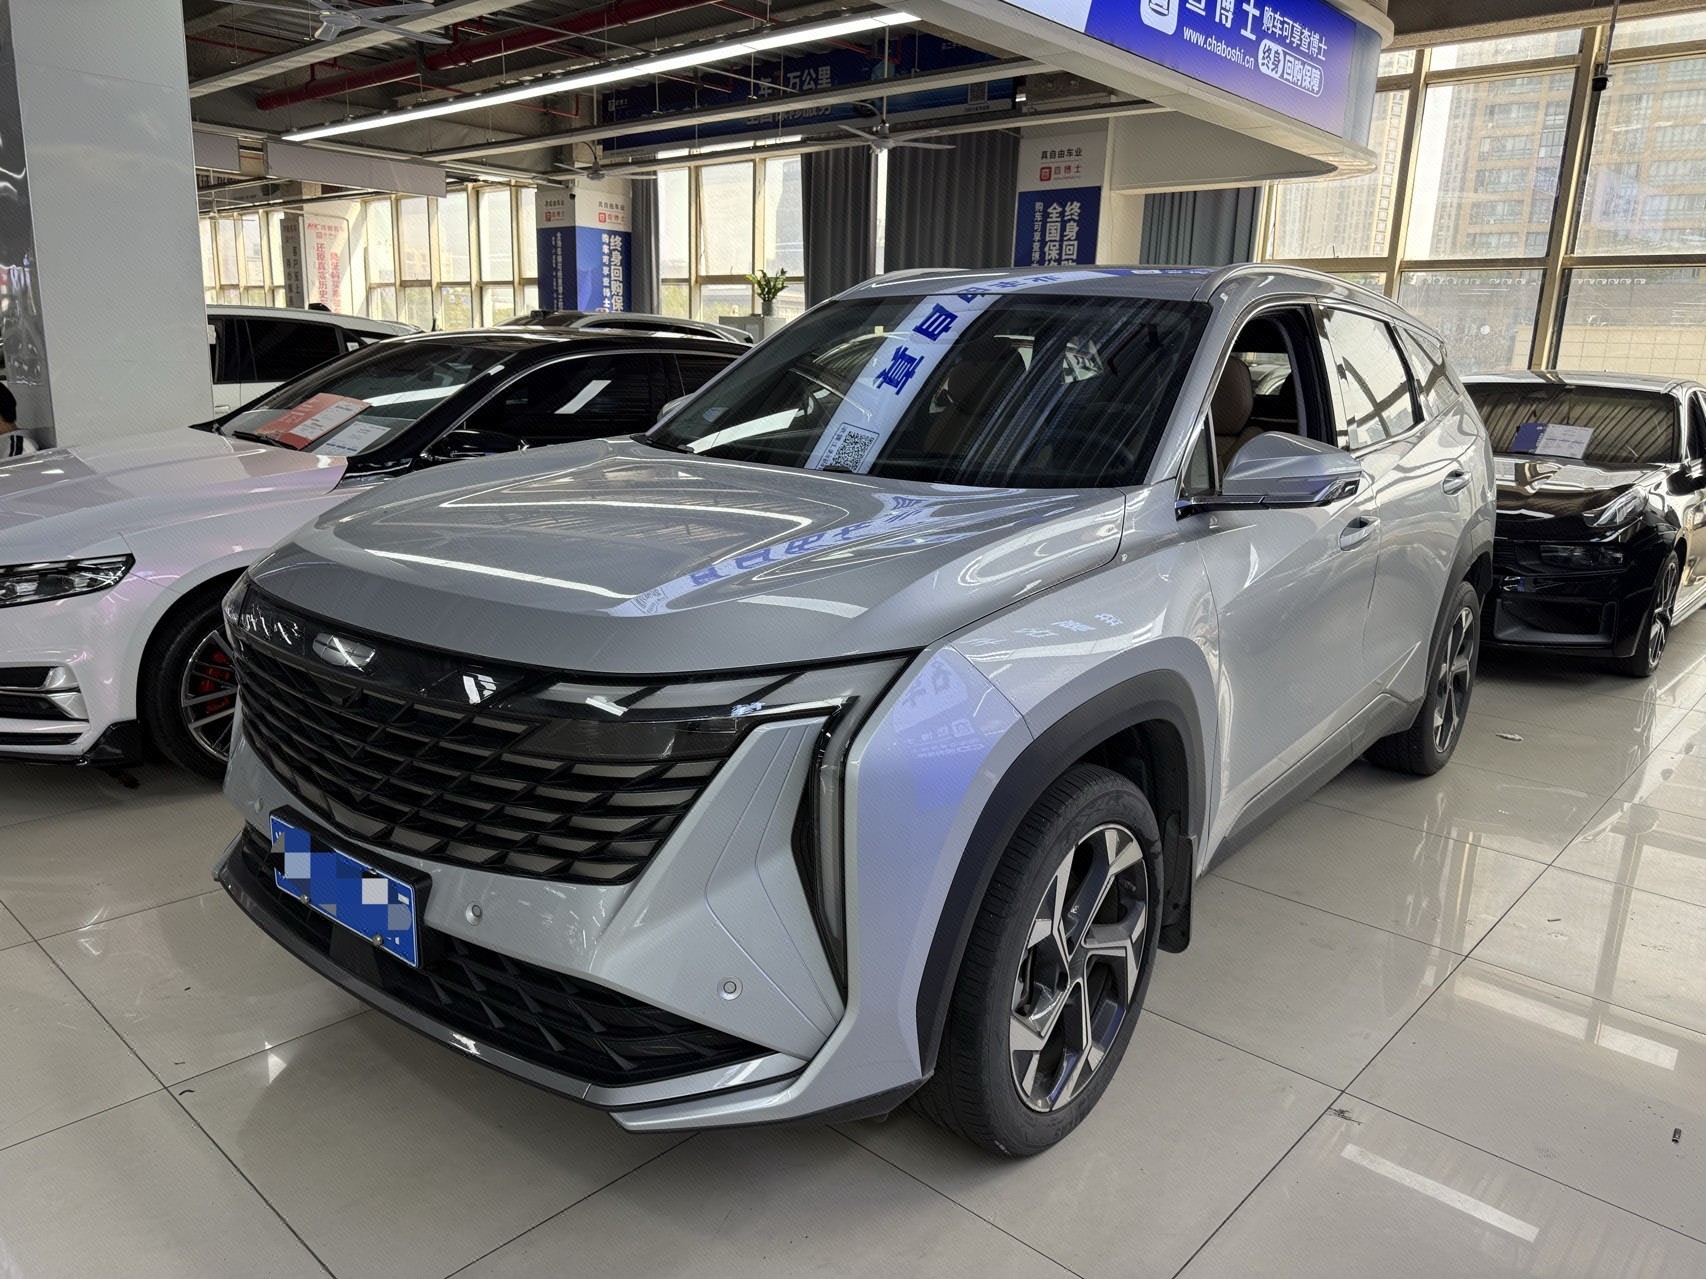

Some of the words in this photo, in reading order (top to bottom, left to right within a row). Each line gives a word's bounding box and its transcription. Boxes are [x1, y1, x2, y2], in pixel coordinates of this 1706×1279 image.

[1183, 26, 1255, 70] www.chaboshi.cn
[1262, 6, 1328, 61] 购车可享查博士
[1041, 147, 1082, 160] 真自由车业
